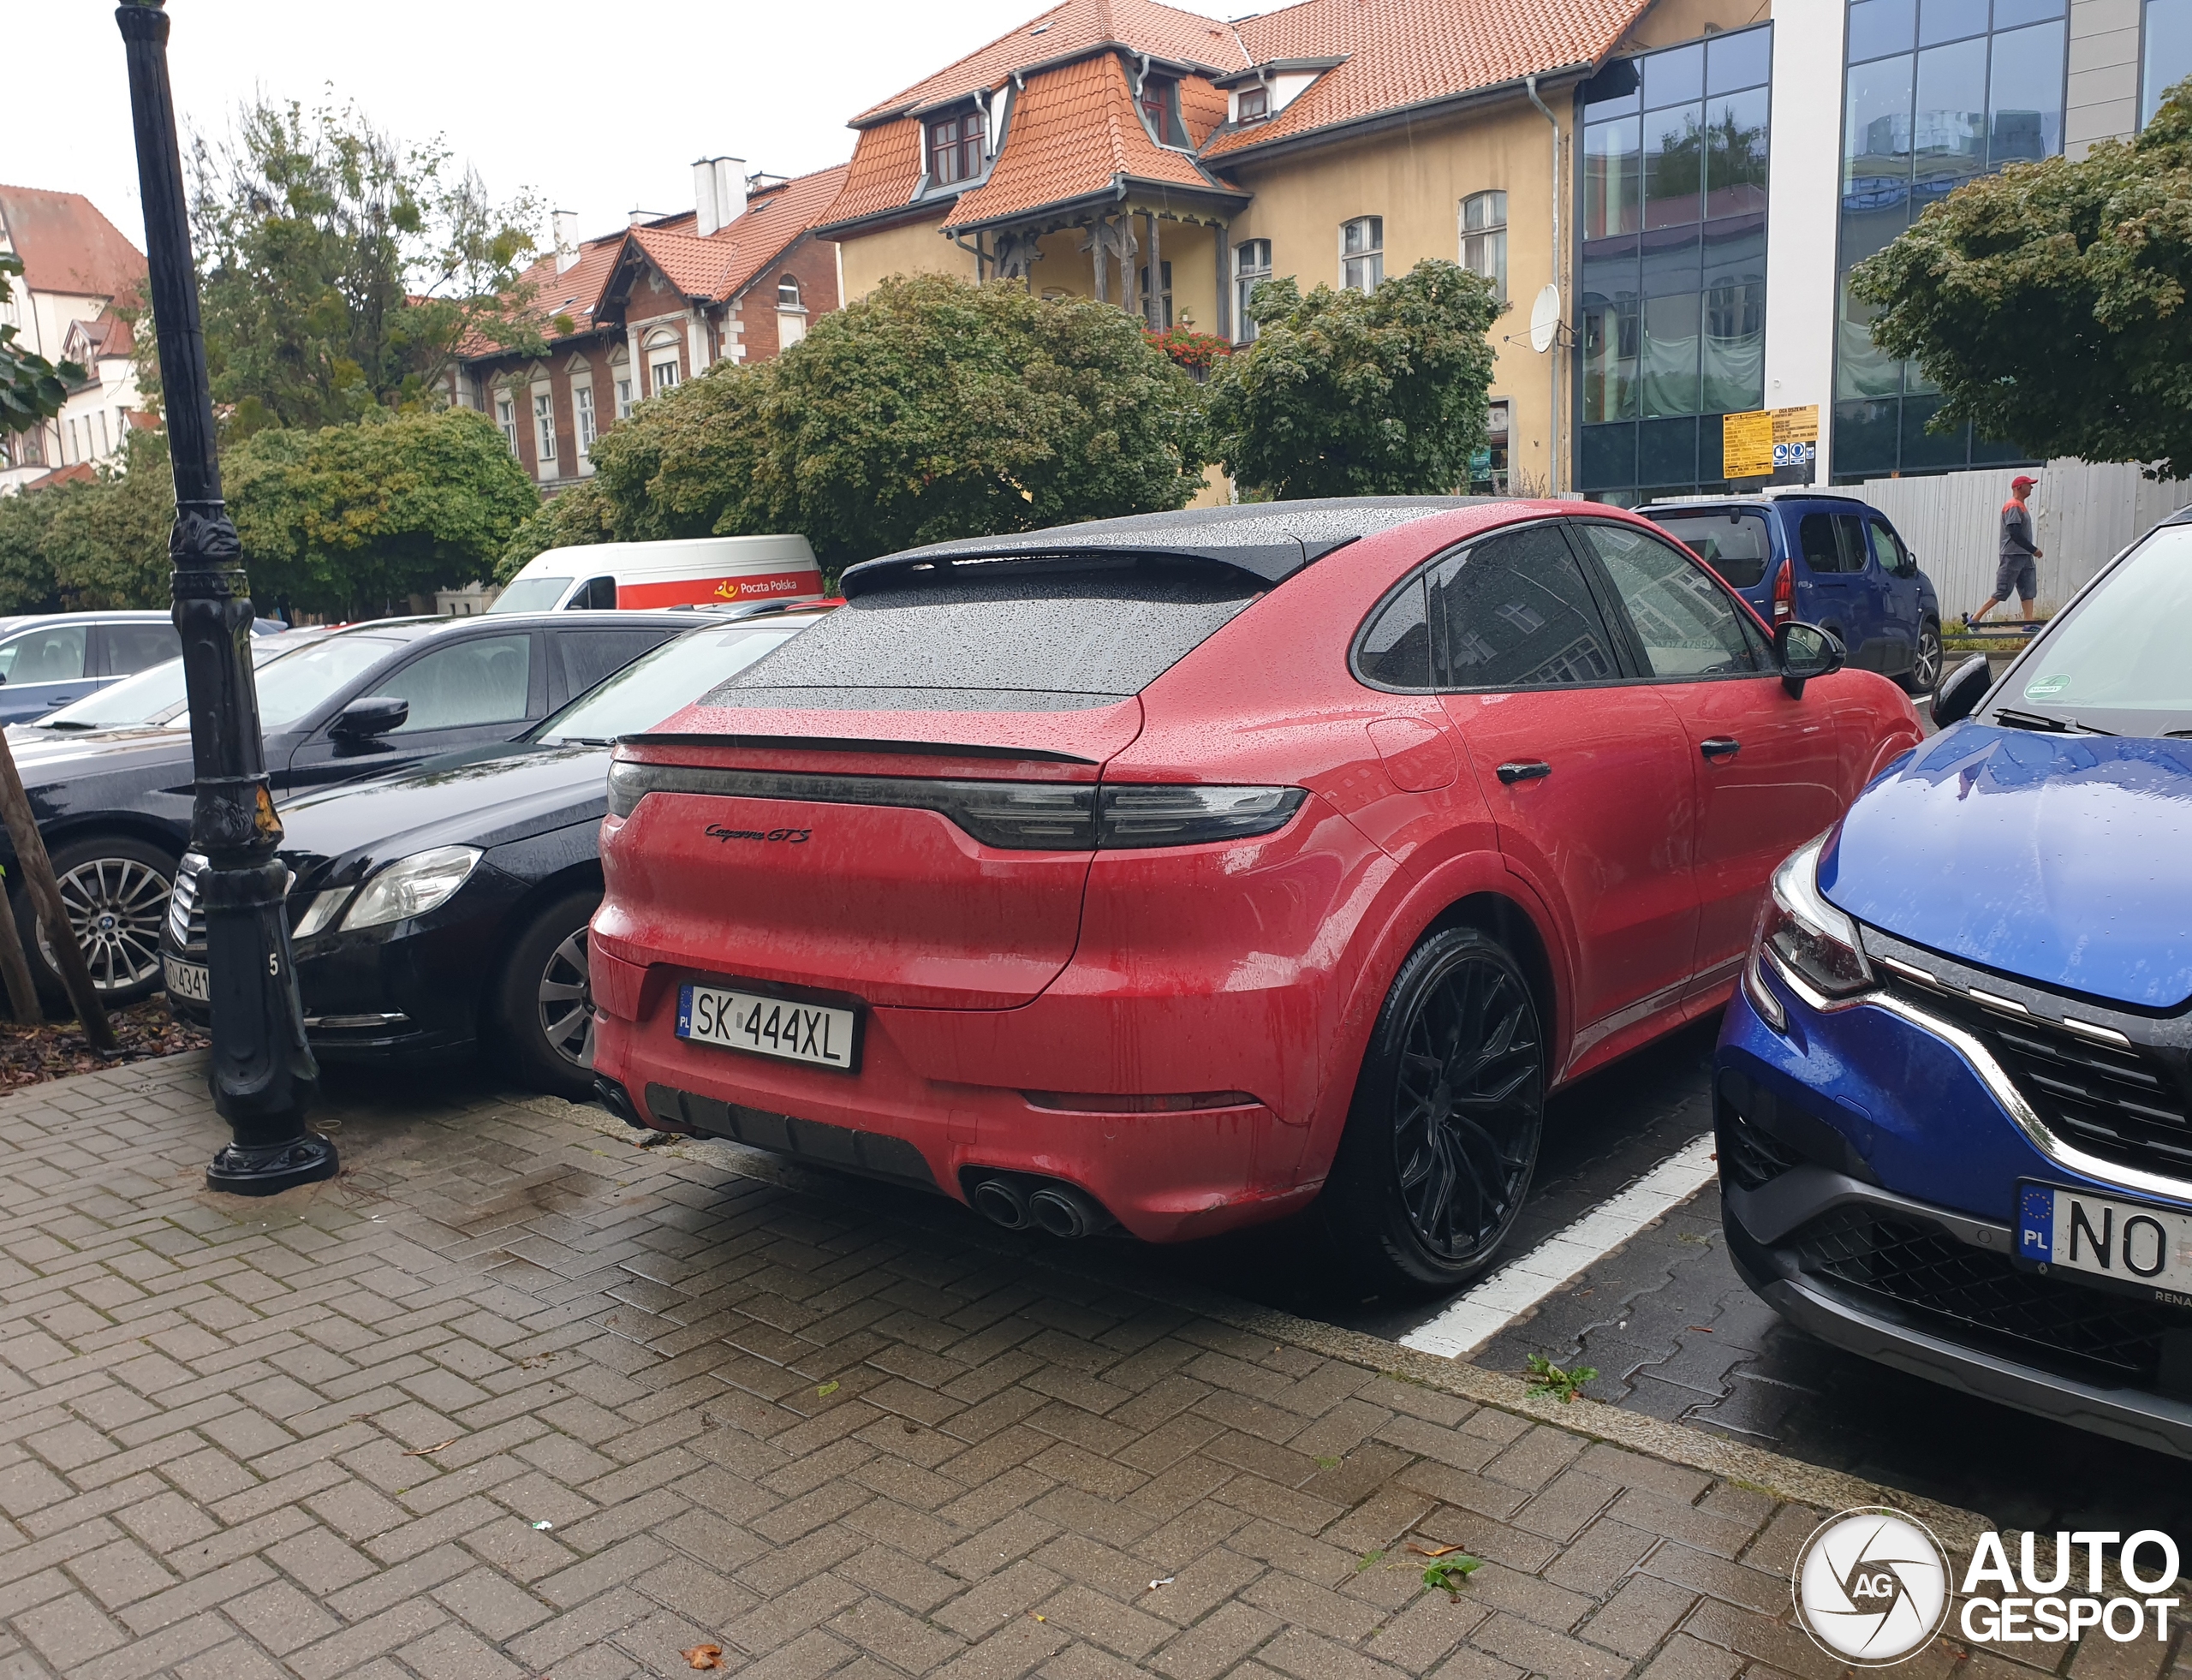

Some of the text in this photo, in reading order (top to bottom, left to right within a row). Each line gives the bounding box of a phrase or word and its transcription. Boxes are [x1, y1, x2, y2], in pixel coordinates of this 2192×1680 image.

[741, 580, 797, 593] Poczta Polska
[704, 824, 813, 843] Cayenne GTS
[269, 953, 279, 976] 5
[680, 1016, 690, 1029] PL
[697, 993, 841, 1061] SK 444XL
[2023, 1229, 2048, 1250] PL
[2069, 1199, 2166, 1278] NO
[2155, 1290, 2192, 1308] RENA
